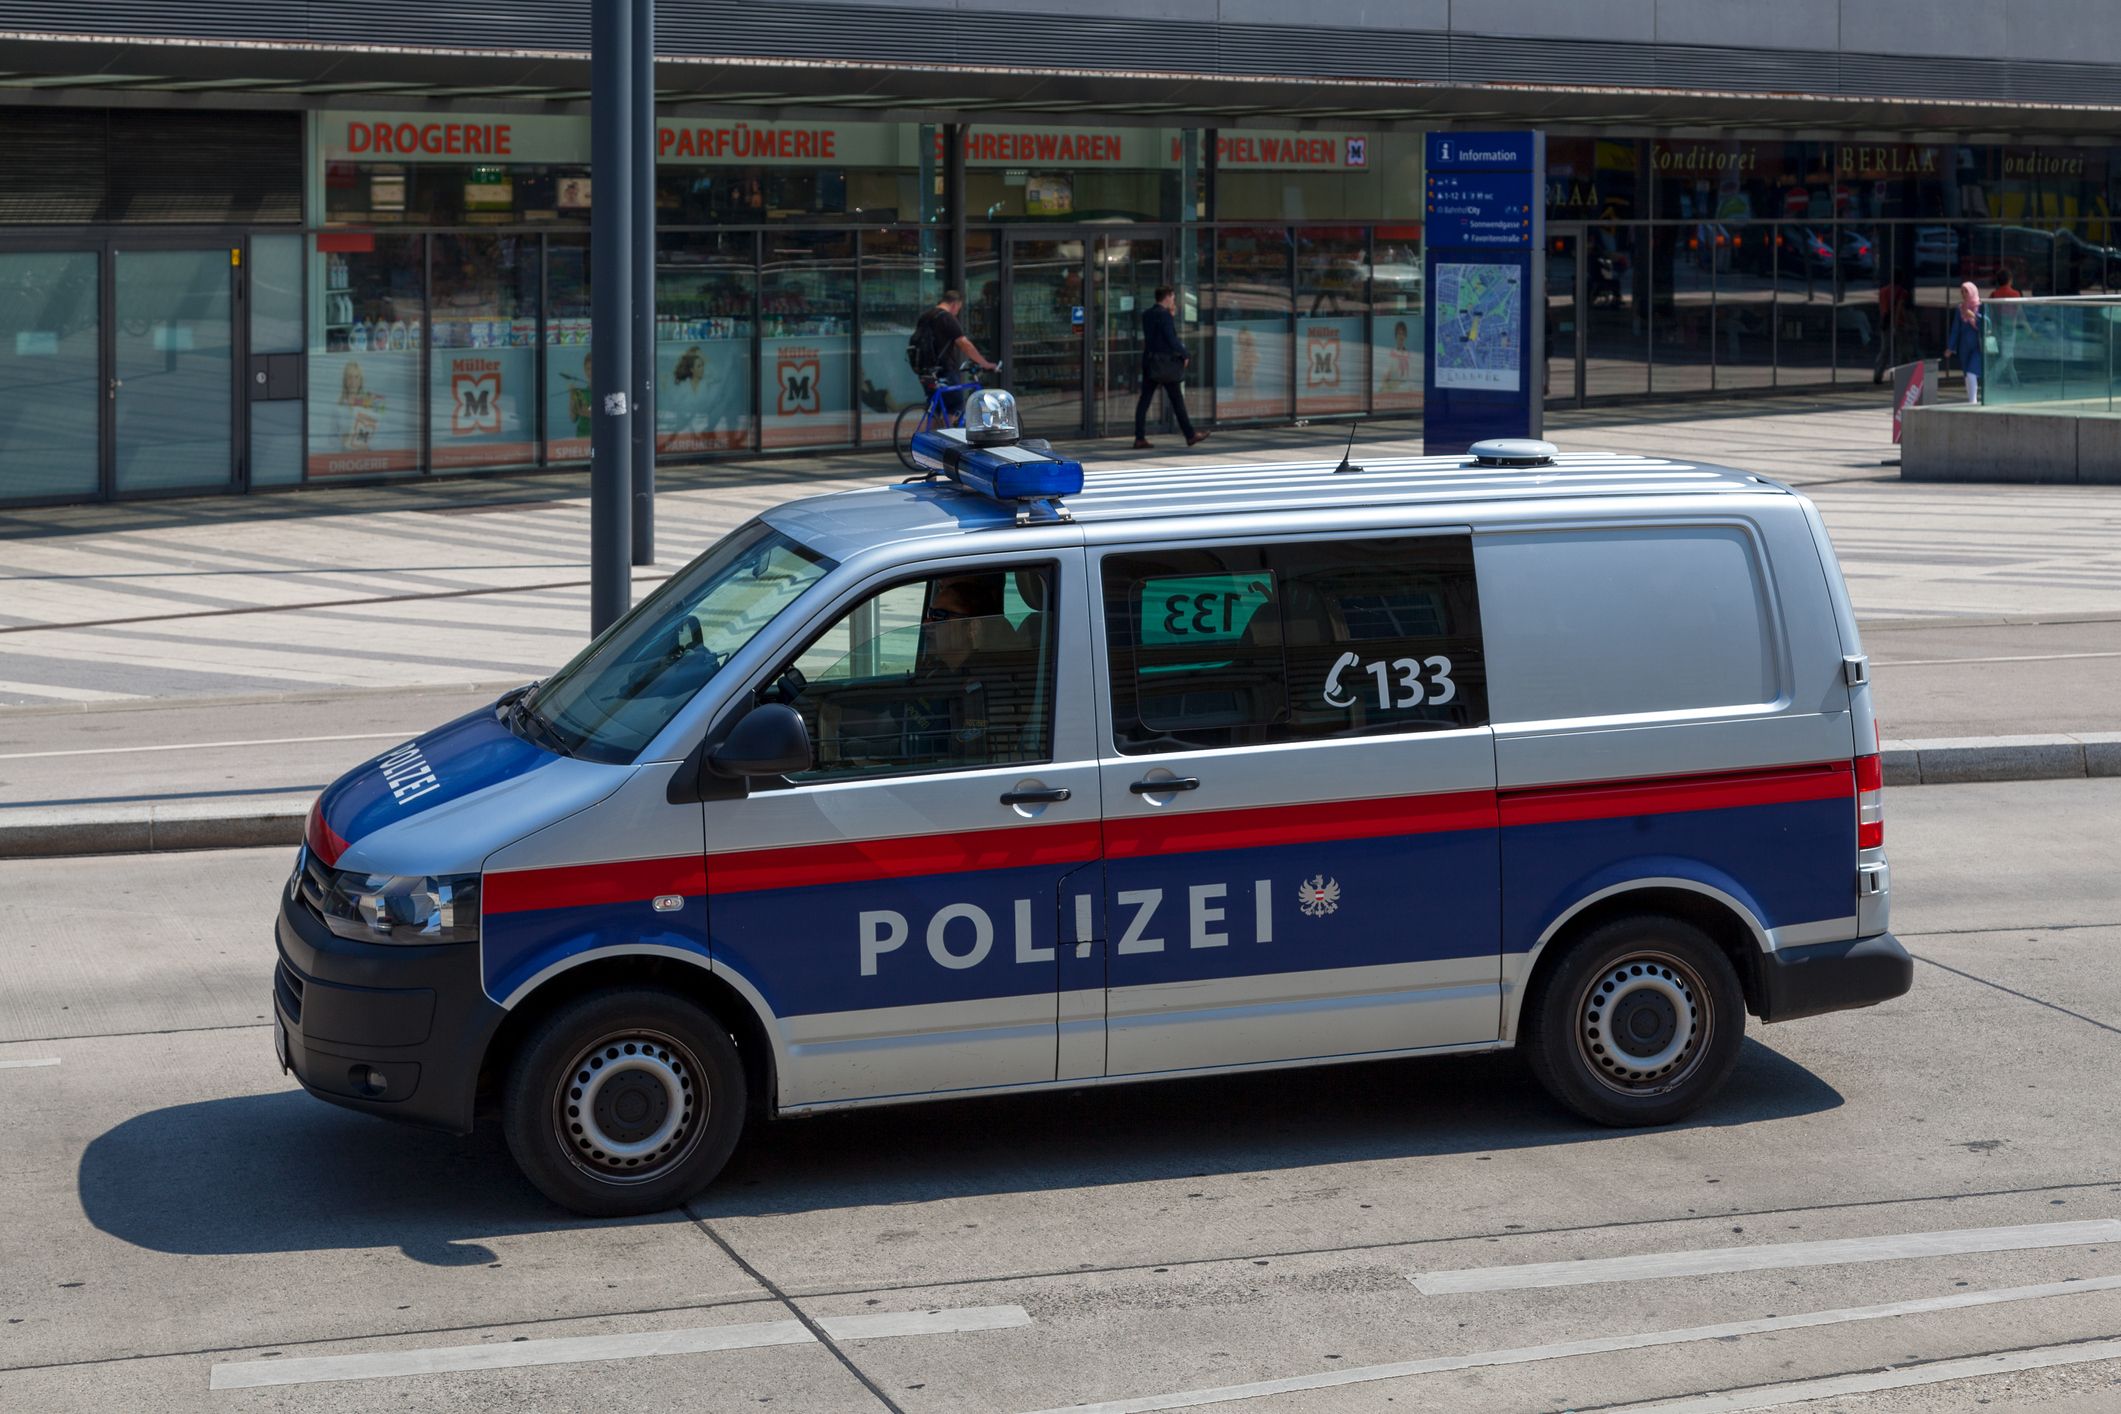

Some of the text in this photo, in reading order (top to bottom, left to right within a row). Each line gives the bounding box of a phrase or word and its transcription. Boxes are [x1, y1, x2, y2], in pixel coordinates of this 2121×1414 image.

[348, 122, 512, 155] DROGERIE
[658, 123, 836, 158] PARFÜMERIE
[933, 133, 1121, 161] SHREIBWAREN
[1459, 149, 1517, 161] Information
[1651, 145, 1757, 170] Konditorei
[1842, 147, 1936, 173] BERLAA
[452, 359, 500, 372] Müller
[1314, 352, 1332, 374] M
[788, 376, 810, 401] M
[463, 390, 489, 417] M
[328, 457, 389, 473] DROGERIE
[1366, 655, 1456, 710] 133
[377, 742, 441, 805] POLIZEI
[859, 879, 1273, 977] POLIZEI
